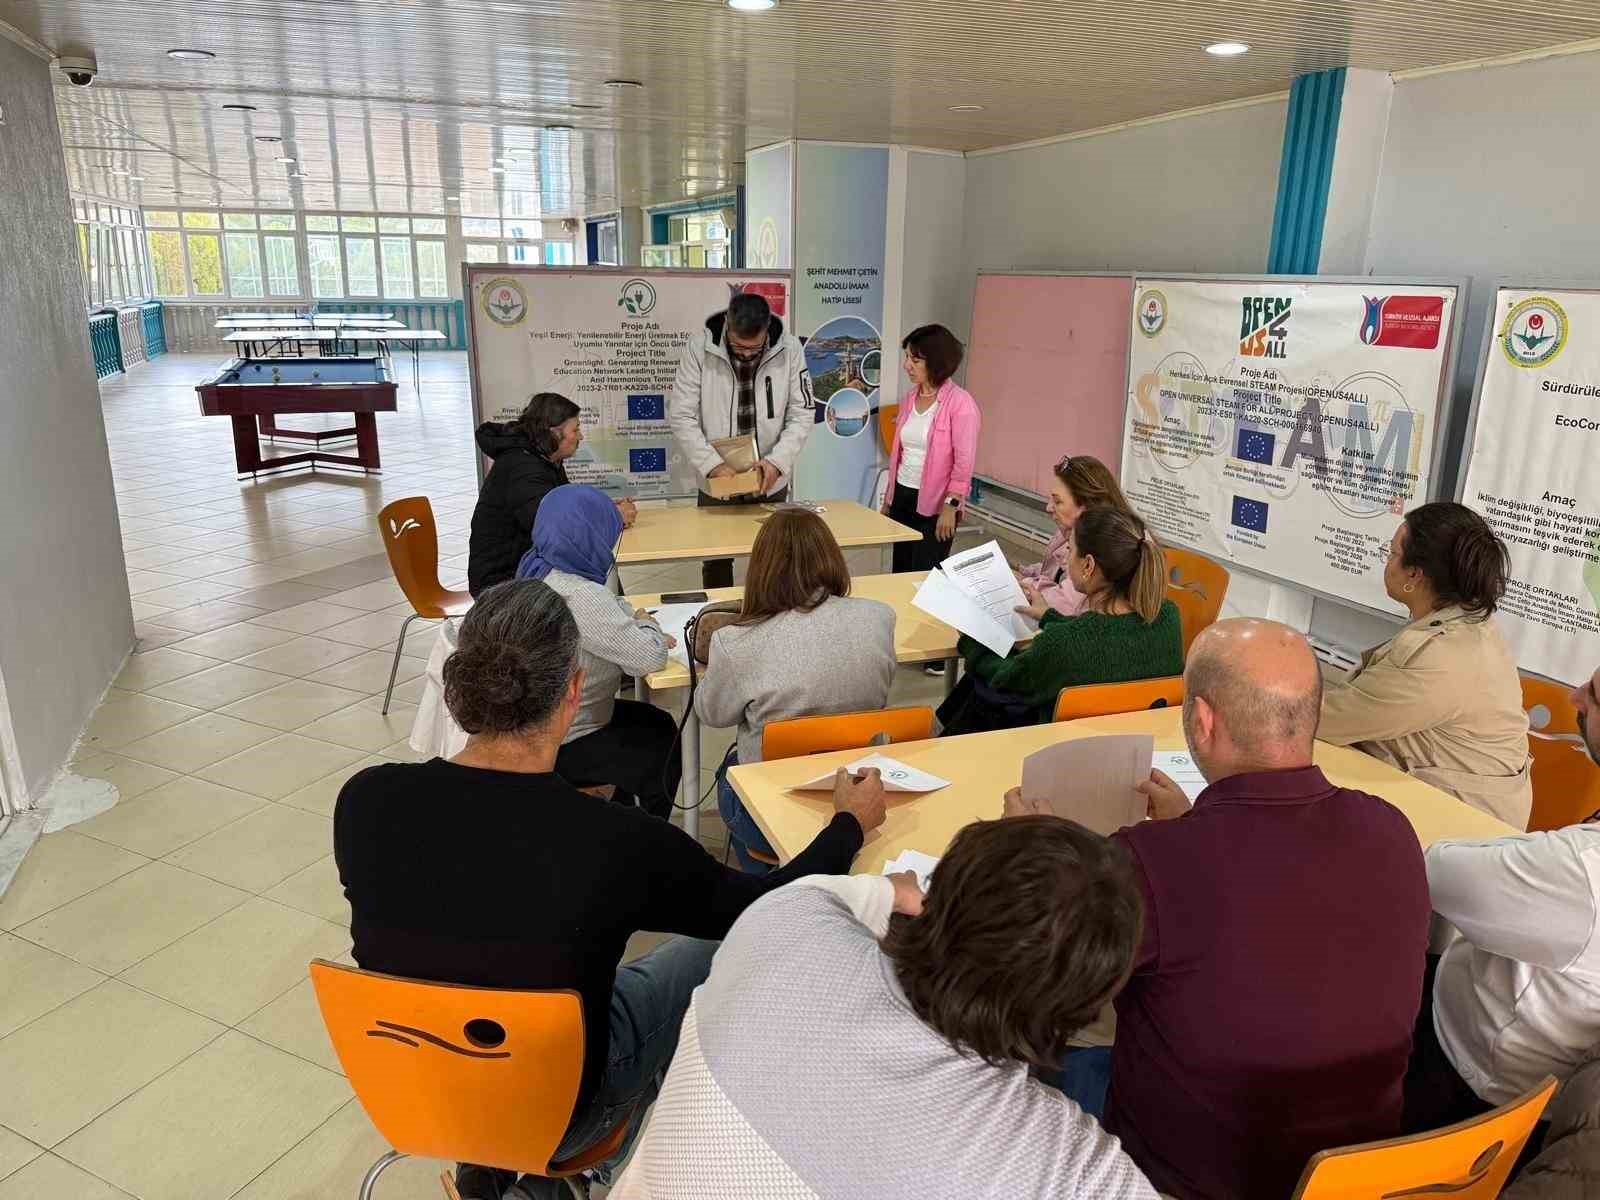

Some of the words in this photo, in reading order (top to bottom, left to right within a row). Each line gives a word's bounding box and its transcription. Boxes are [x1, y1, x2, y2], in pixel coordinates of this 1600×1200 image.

[827, 268, 856, 276] MEHMET
[857, 267, 878, 277] ÇETİN
[814, 282, 848, 290] ANADOLU
[849, 281, 869, 290] İMAM
[821, 296, 842, 304] HATİP
[621, 322, 643, 332] Proje
[625, 331, 647, 341] Enerji
[574, 340, 604, 349] Uyumlu
[1264, 340, 1287, 359] ALL
[616, 349, 646, 359] Project
[648, 349, 666, 357] Title
[608, 359, 649, 368] Generating
[553, 367, 592, 375] Education
[593, 367, 625, 375] Network
[626, 367, 656, 376] Leading
[1240, 367, 1262, 380] Proje
[1262, 369, 1277, 380] Adı
[607, 376, 651, 384] Harmonious
[1219, 376, 1249, 387] Evrensel
[1250, 380, 1277, 391] STEAM
[1542, 380, 1600, 397] Sürdürüle
[1160, 389, 1177, 399] OPEN
[1178, 392, 1214, 405] UNIVERSAL
[1216, 398, 1240, 410] STEAM
[1241, 403, 1258, 413] FOR
[1233, 388, 1262, 402] Project
[1263, 393, 1282, 405] Title
[1341, 446, 1375, 460] Katkılar
[1542, 490, 1577, 509] Amaç
[1485, 506, 1533, 523] vatandaşlık
[1534, 517, 1552, 527] gibi
[1553, 520, 1583, 534] hayati
[1494, 529, 1550, 551] okuryazarlığı
[1533, 528, 1561, 542] teşvik
[1562, 535, 1595, 549] ederek
[1532, 586, 1578, 605] ORTAKLARI
